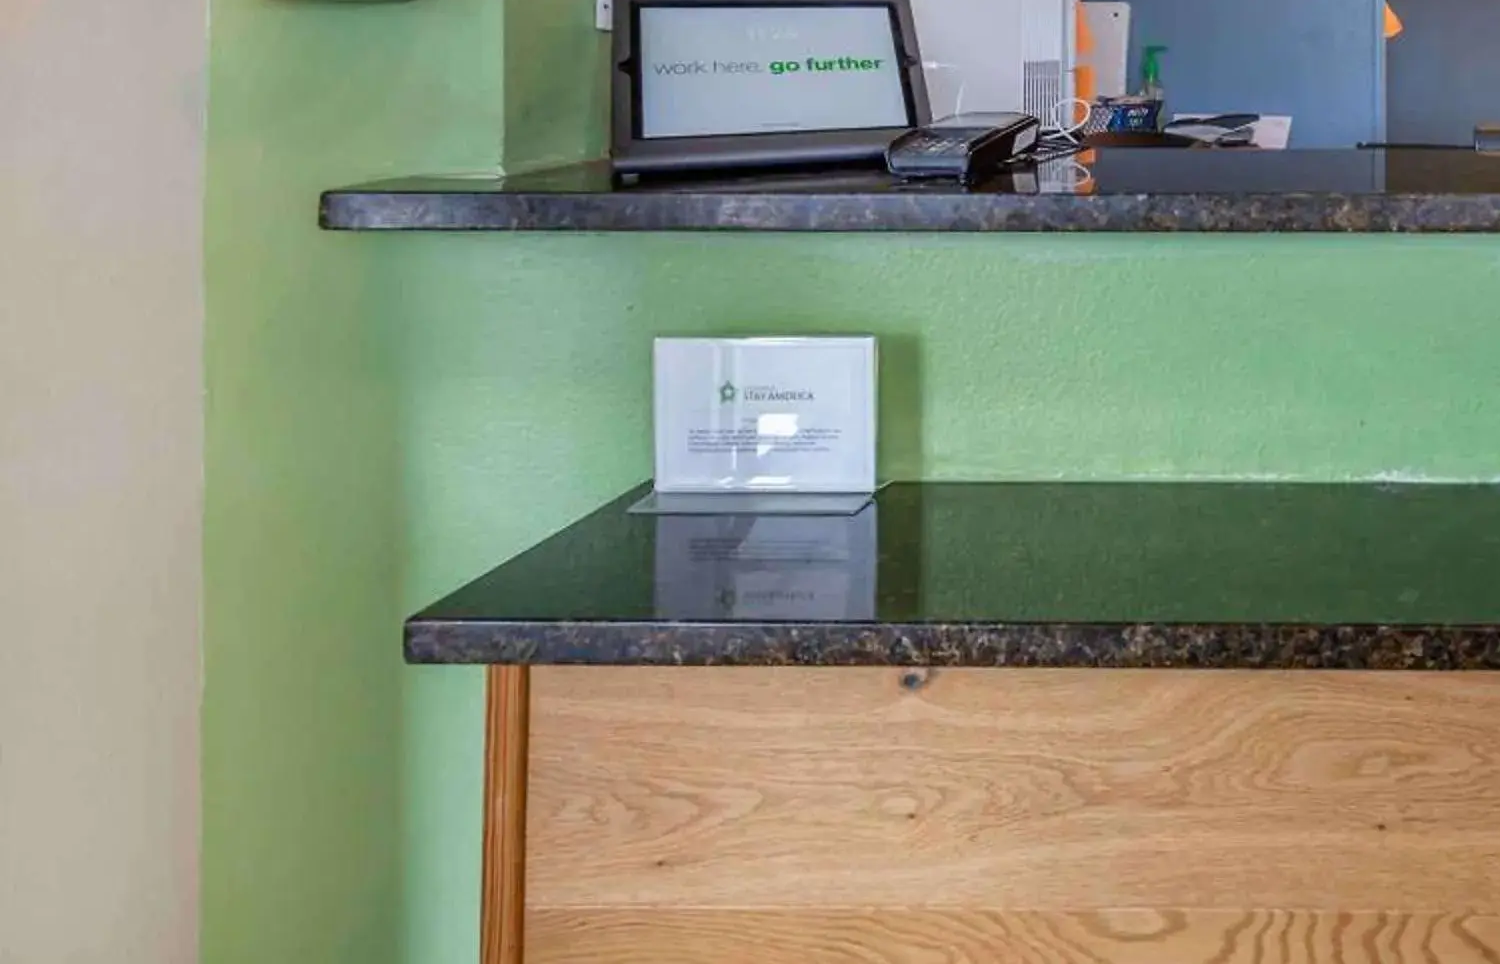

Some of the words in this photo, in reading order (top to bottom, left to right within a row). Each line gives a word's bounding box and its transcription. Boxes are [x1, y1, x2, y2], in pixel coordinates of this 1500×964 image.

[653, 61, 708, 75] work
[769, 60, 800, 75] go
[806, 57, 886, 72] further
